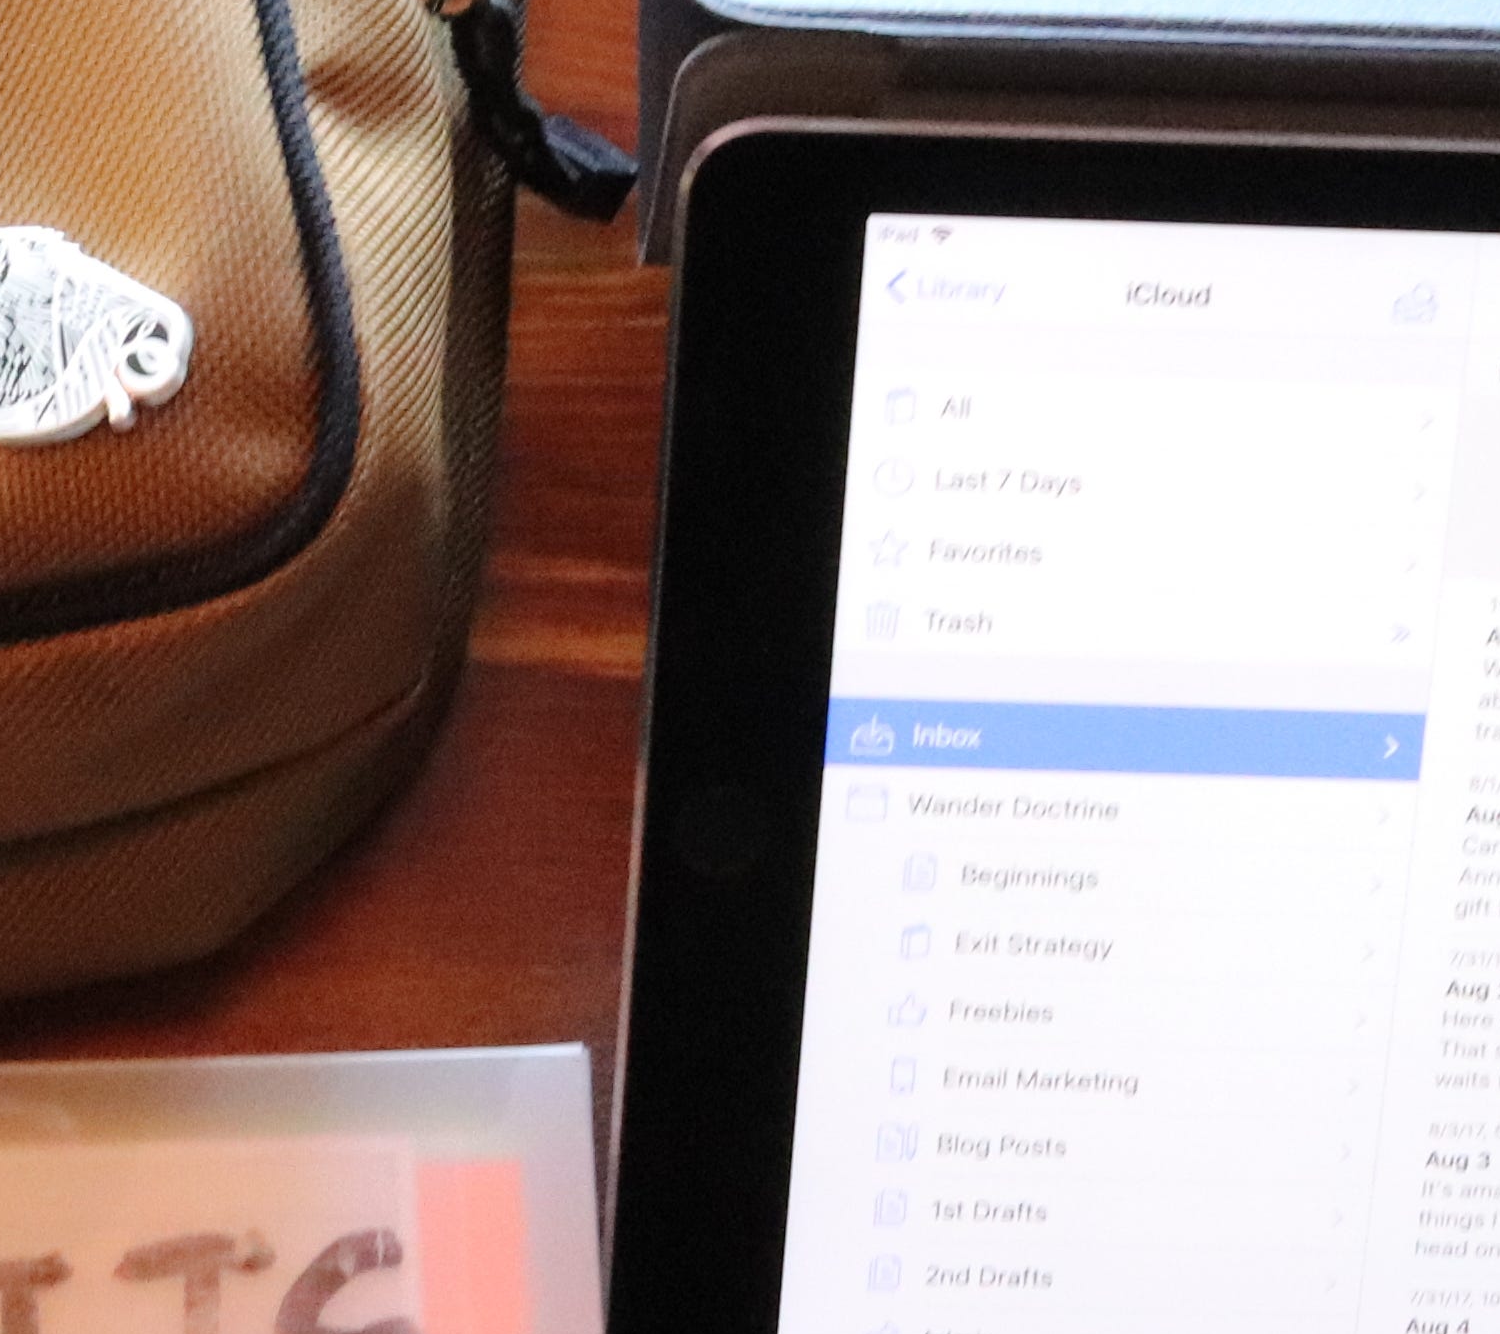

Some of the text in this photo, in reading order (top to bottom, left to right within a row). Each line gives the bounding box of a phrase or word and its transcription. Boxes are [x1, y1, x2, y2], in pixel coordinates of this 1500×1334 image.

[916, 275, 1008, 305] Library
[1126, 283, 1212, 307] iCloud
[940, 396, 972, 419] All
[935, 469, 1082, 498] Last 7 Days
[928, 539, 1042, 565] Favorites
[925, 609, 993, 634] Trash
[911, 720, 983, 750] Inbox
[908, 793, 1120, 821] Wander Doctrine
[961, 864, 1099, 893] Beginnings
[955, 931, 1113, 962] Exit Strategy
[1445, 979, 1490, 1003] Aug
[949, 999, 1054, 1023] Freebies
[1440, 1038, 1488, 1060] That
[943, 1067, 1139, 1097] Email Marketing
[936, 1133, 1067, 1161] Blog Posts
[1425, 1150, 1491, 1173] Aug 3
[932, 1199, 1047, 1222] 1st Drafts
[926, 1265, 1053, 1288] 2nd Drafts
